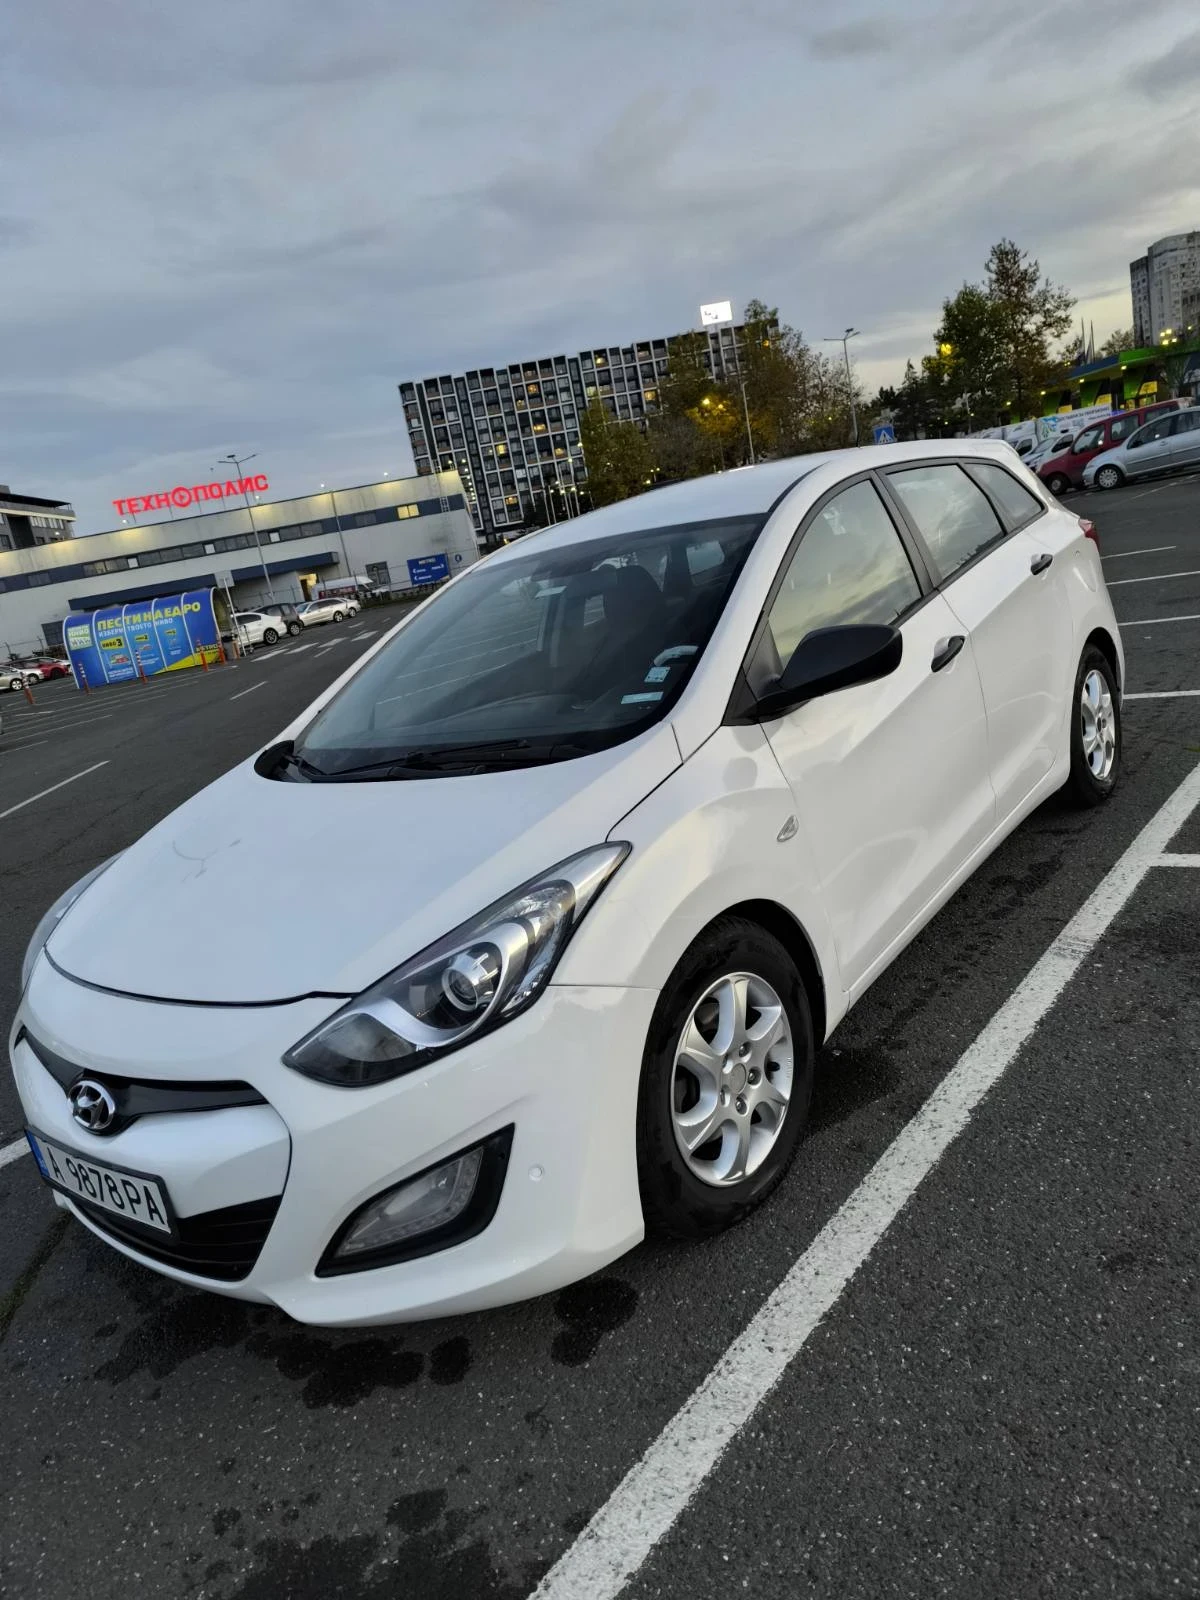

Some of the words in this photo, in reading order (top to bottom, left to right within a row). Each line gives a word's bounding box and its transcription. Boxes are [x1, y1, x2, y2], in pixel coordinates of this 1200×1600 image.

[113, 474, 269, 516] ТЕХНОПОЛИС
[97, 613, 141, 631] ПЕСТИ
[144, 609, 163, 622] НА
[165, 601, 201, 617] ЕДРО
